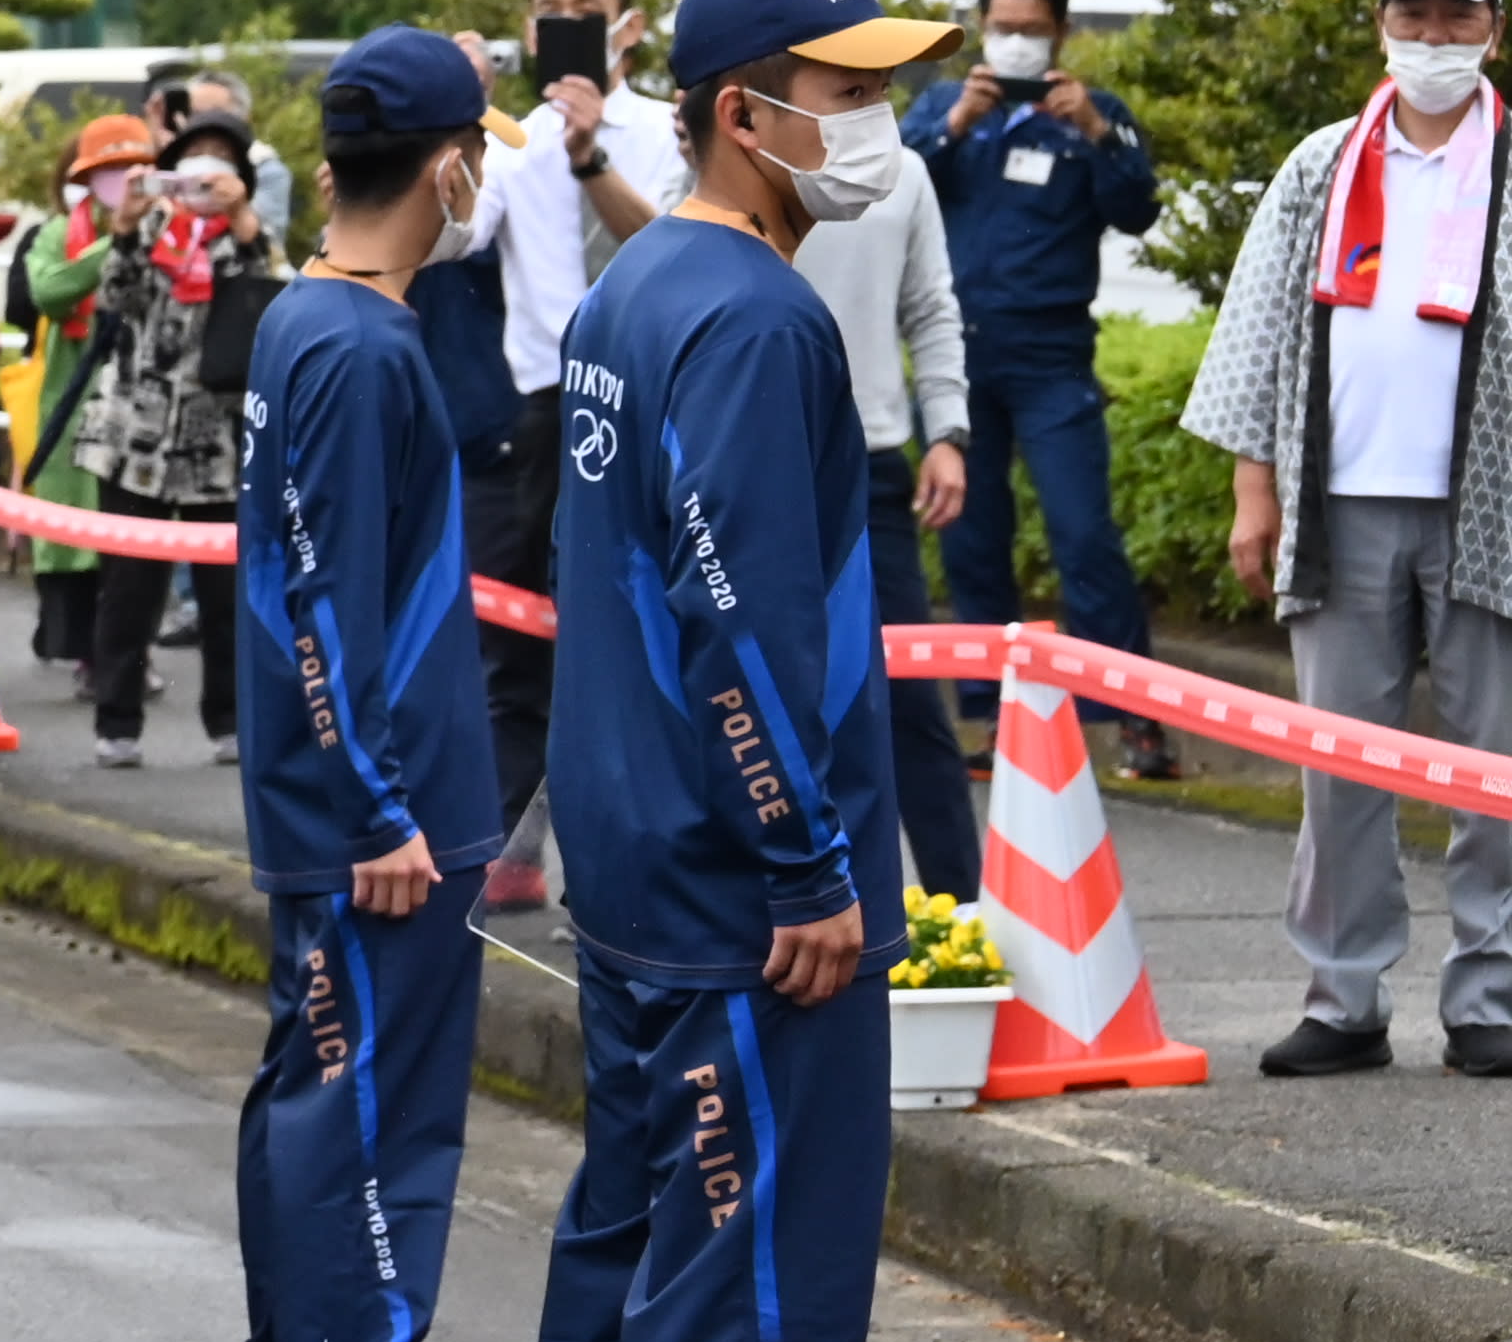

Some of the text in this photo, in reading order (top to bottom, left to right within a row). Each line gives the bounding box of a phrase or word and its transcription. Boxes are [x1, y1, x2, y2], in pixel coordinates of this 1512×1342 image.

[683, 491, 737, 611] TOKYO 2020
[295, 635, 338, 749] POLICE
[709, 686, 791, 825] POLICE
[306, 949, 347, 1085] POLICE
[684, 1064, 742, 1228] POLICE
[374, 1236, 397, 1280] 2020
